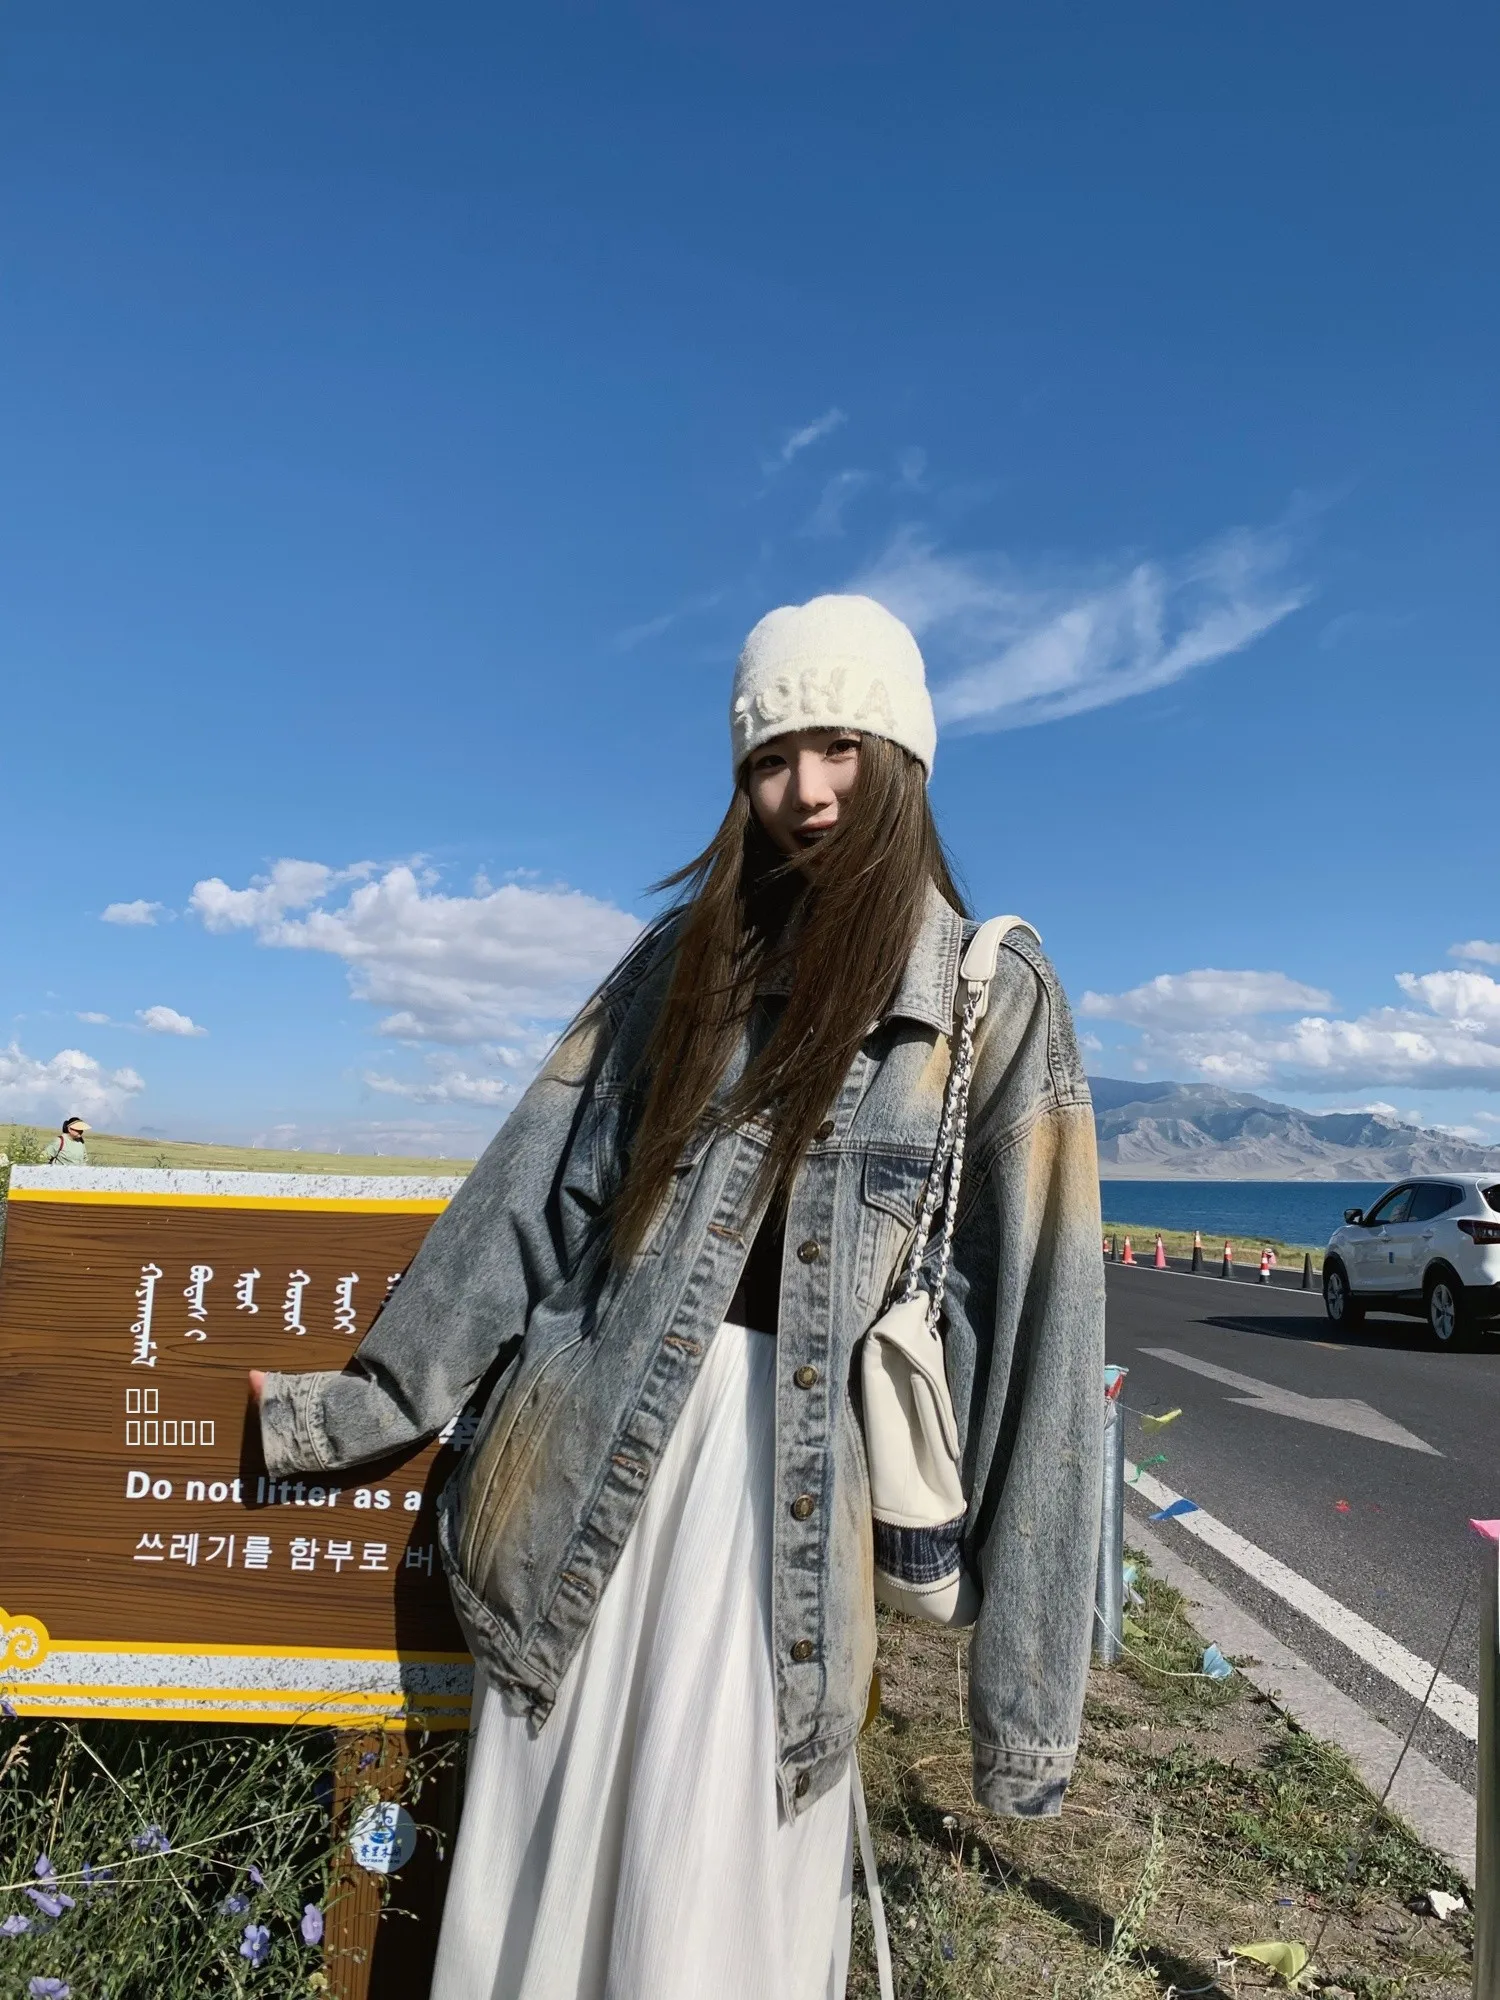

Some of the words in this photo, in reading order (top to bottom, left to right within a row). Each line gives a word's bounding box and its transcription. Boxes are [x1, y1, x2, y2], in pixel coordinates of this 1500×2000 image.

[125, 1470, 172, 1500] Do
[185, 1478, 243, 1503] not
[256, 1477, 342, 1507] litter
[353, 1488, 391, 1510] as
[403, 1490, 422, 1511] a
[133, 1532, 273, 1569] 쓰레기를
[288, 1537, 390, 1573] 함부로
